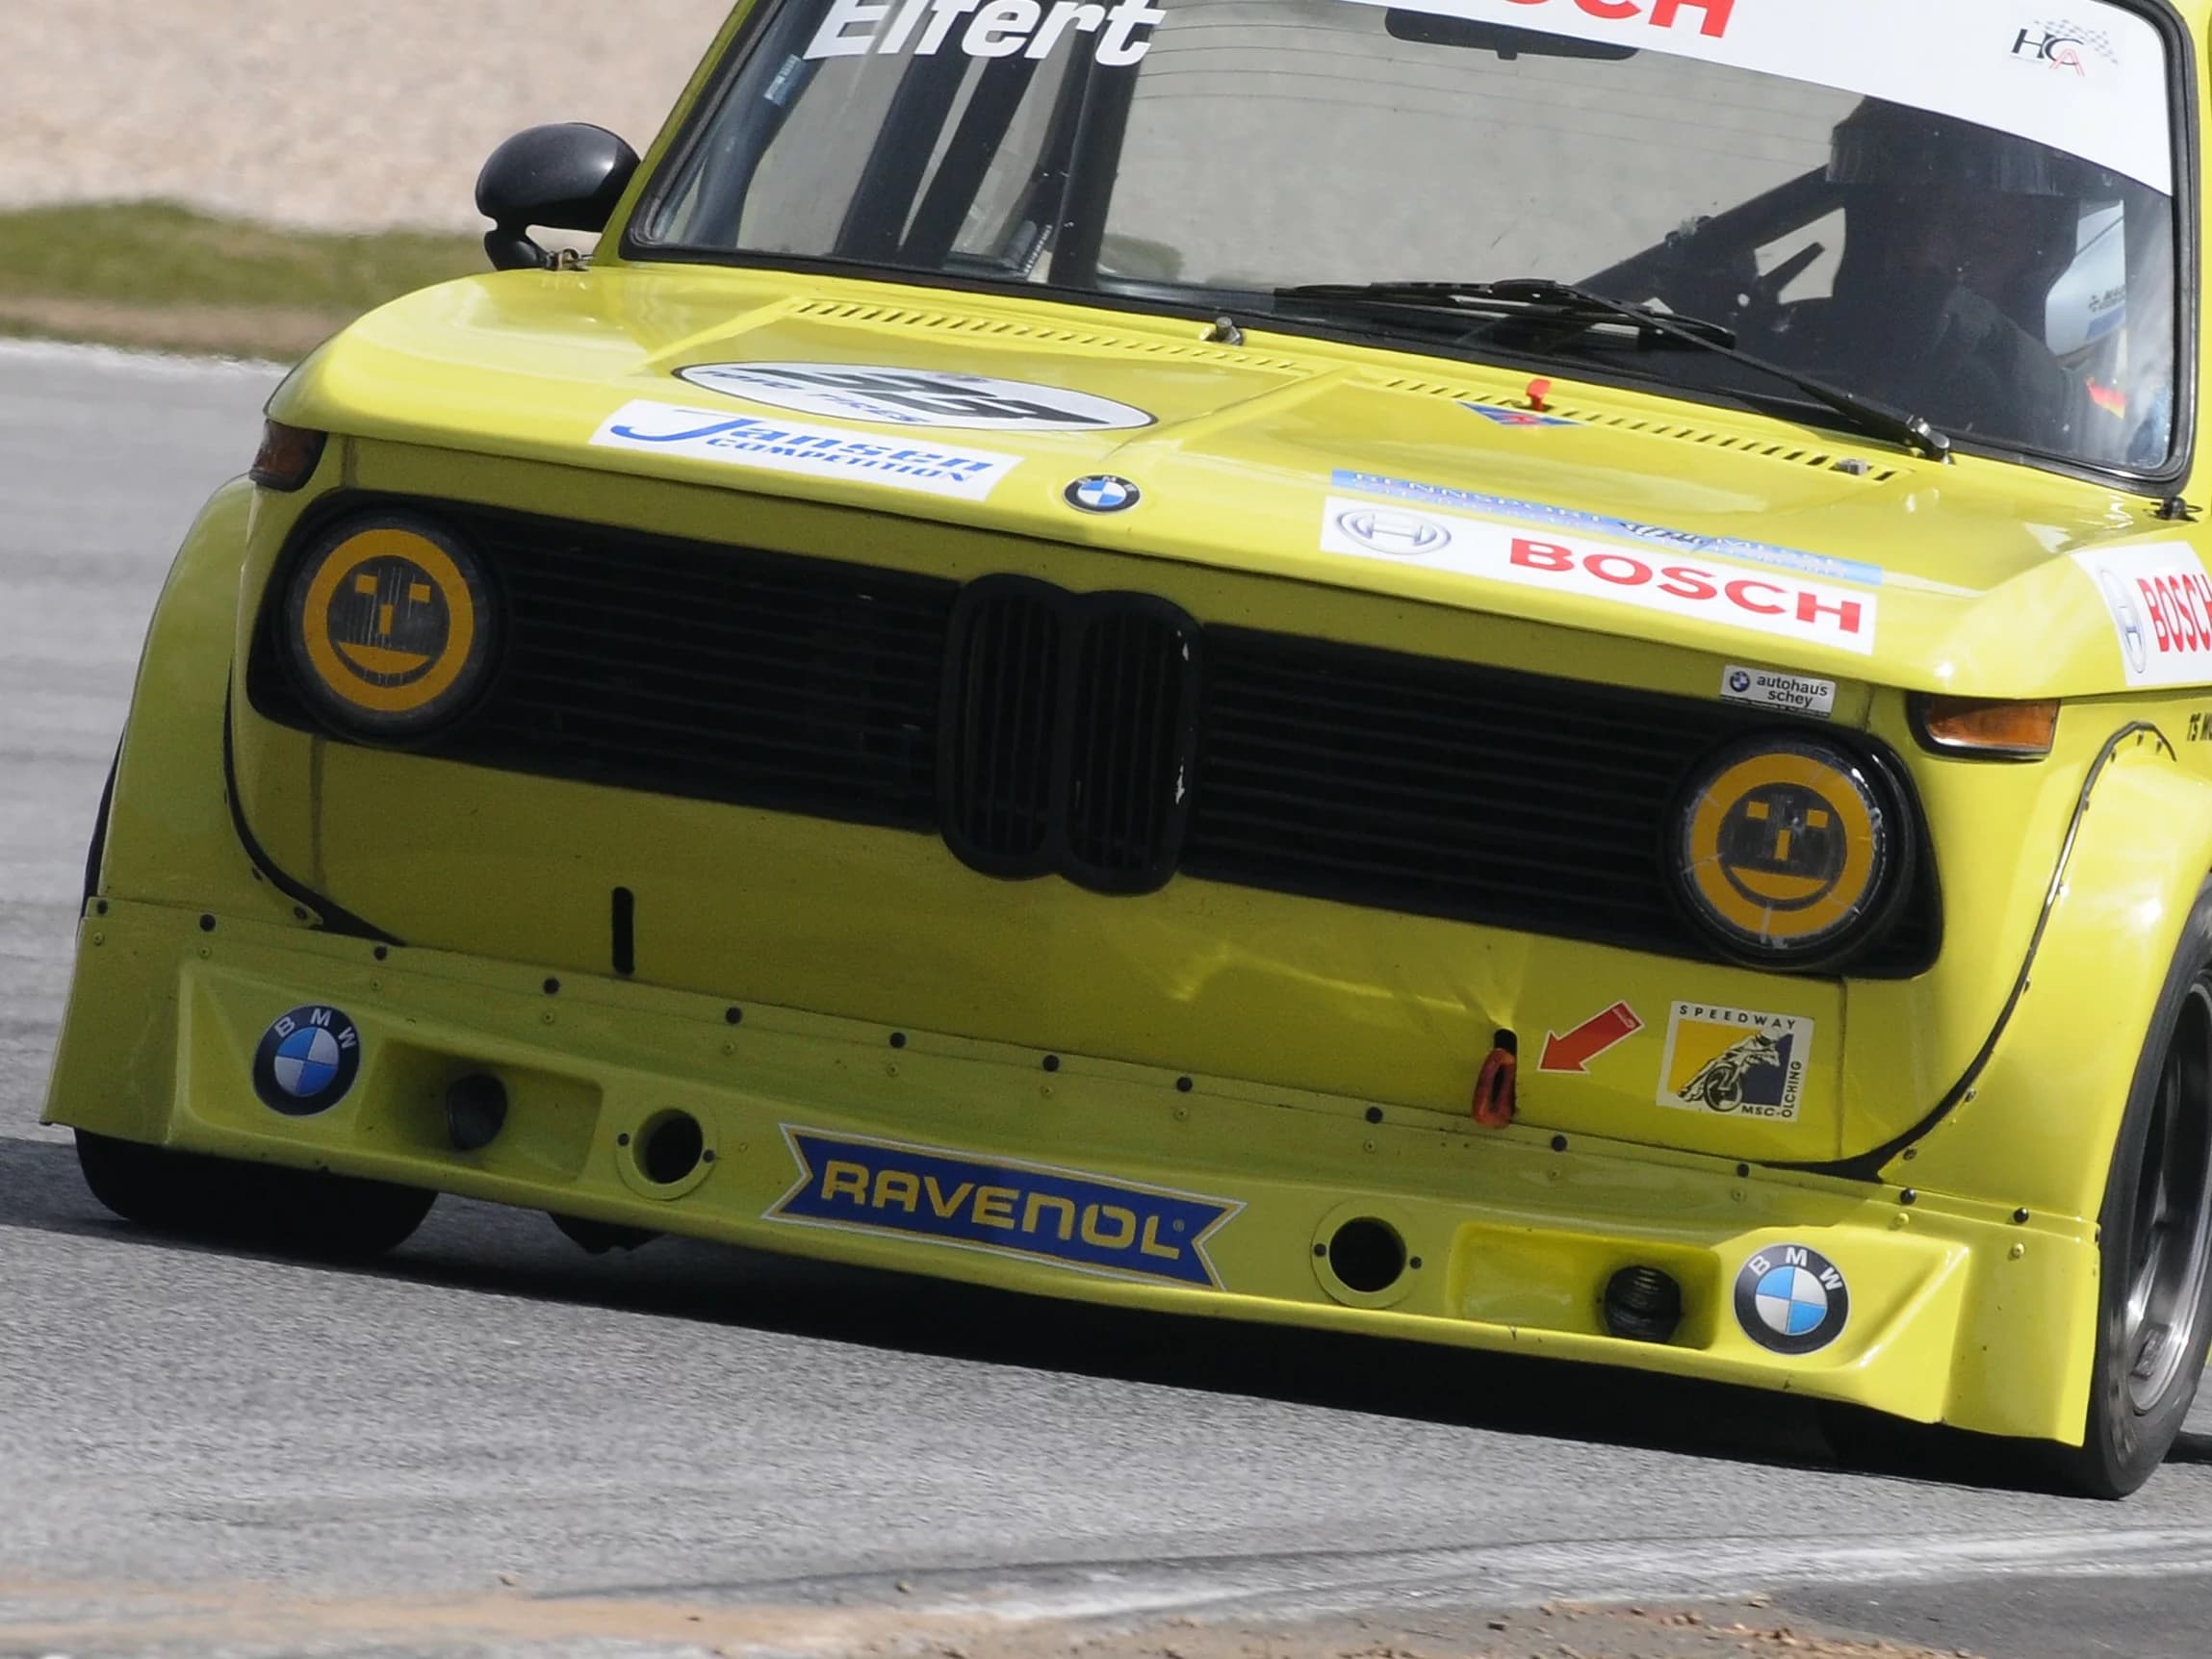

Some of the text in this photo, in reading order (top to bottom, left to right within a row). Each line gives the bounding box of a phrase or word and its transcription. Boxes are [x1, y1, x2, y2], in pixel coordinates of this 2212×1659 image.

[610, 409, 994, 472] Jansen
[707, 438, 970, 482] COMPETITION
[1509, 537, 1862, 634] BOSCH
[1757, 676, 1828, 697] autohaus
[1767, 690, 1813, 707] schey
[274, 1007, 357, 1050] BMW
[1679, 1005, 1796, 1030] SPEEDWAY
[820, 1160, 1181, 1261] RAVENOL
[1748, 1246, 1843, 1290] BMW
